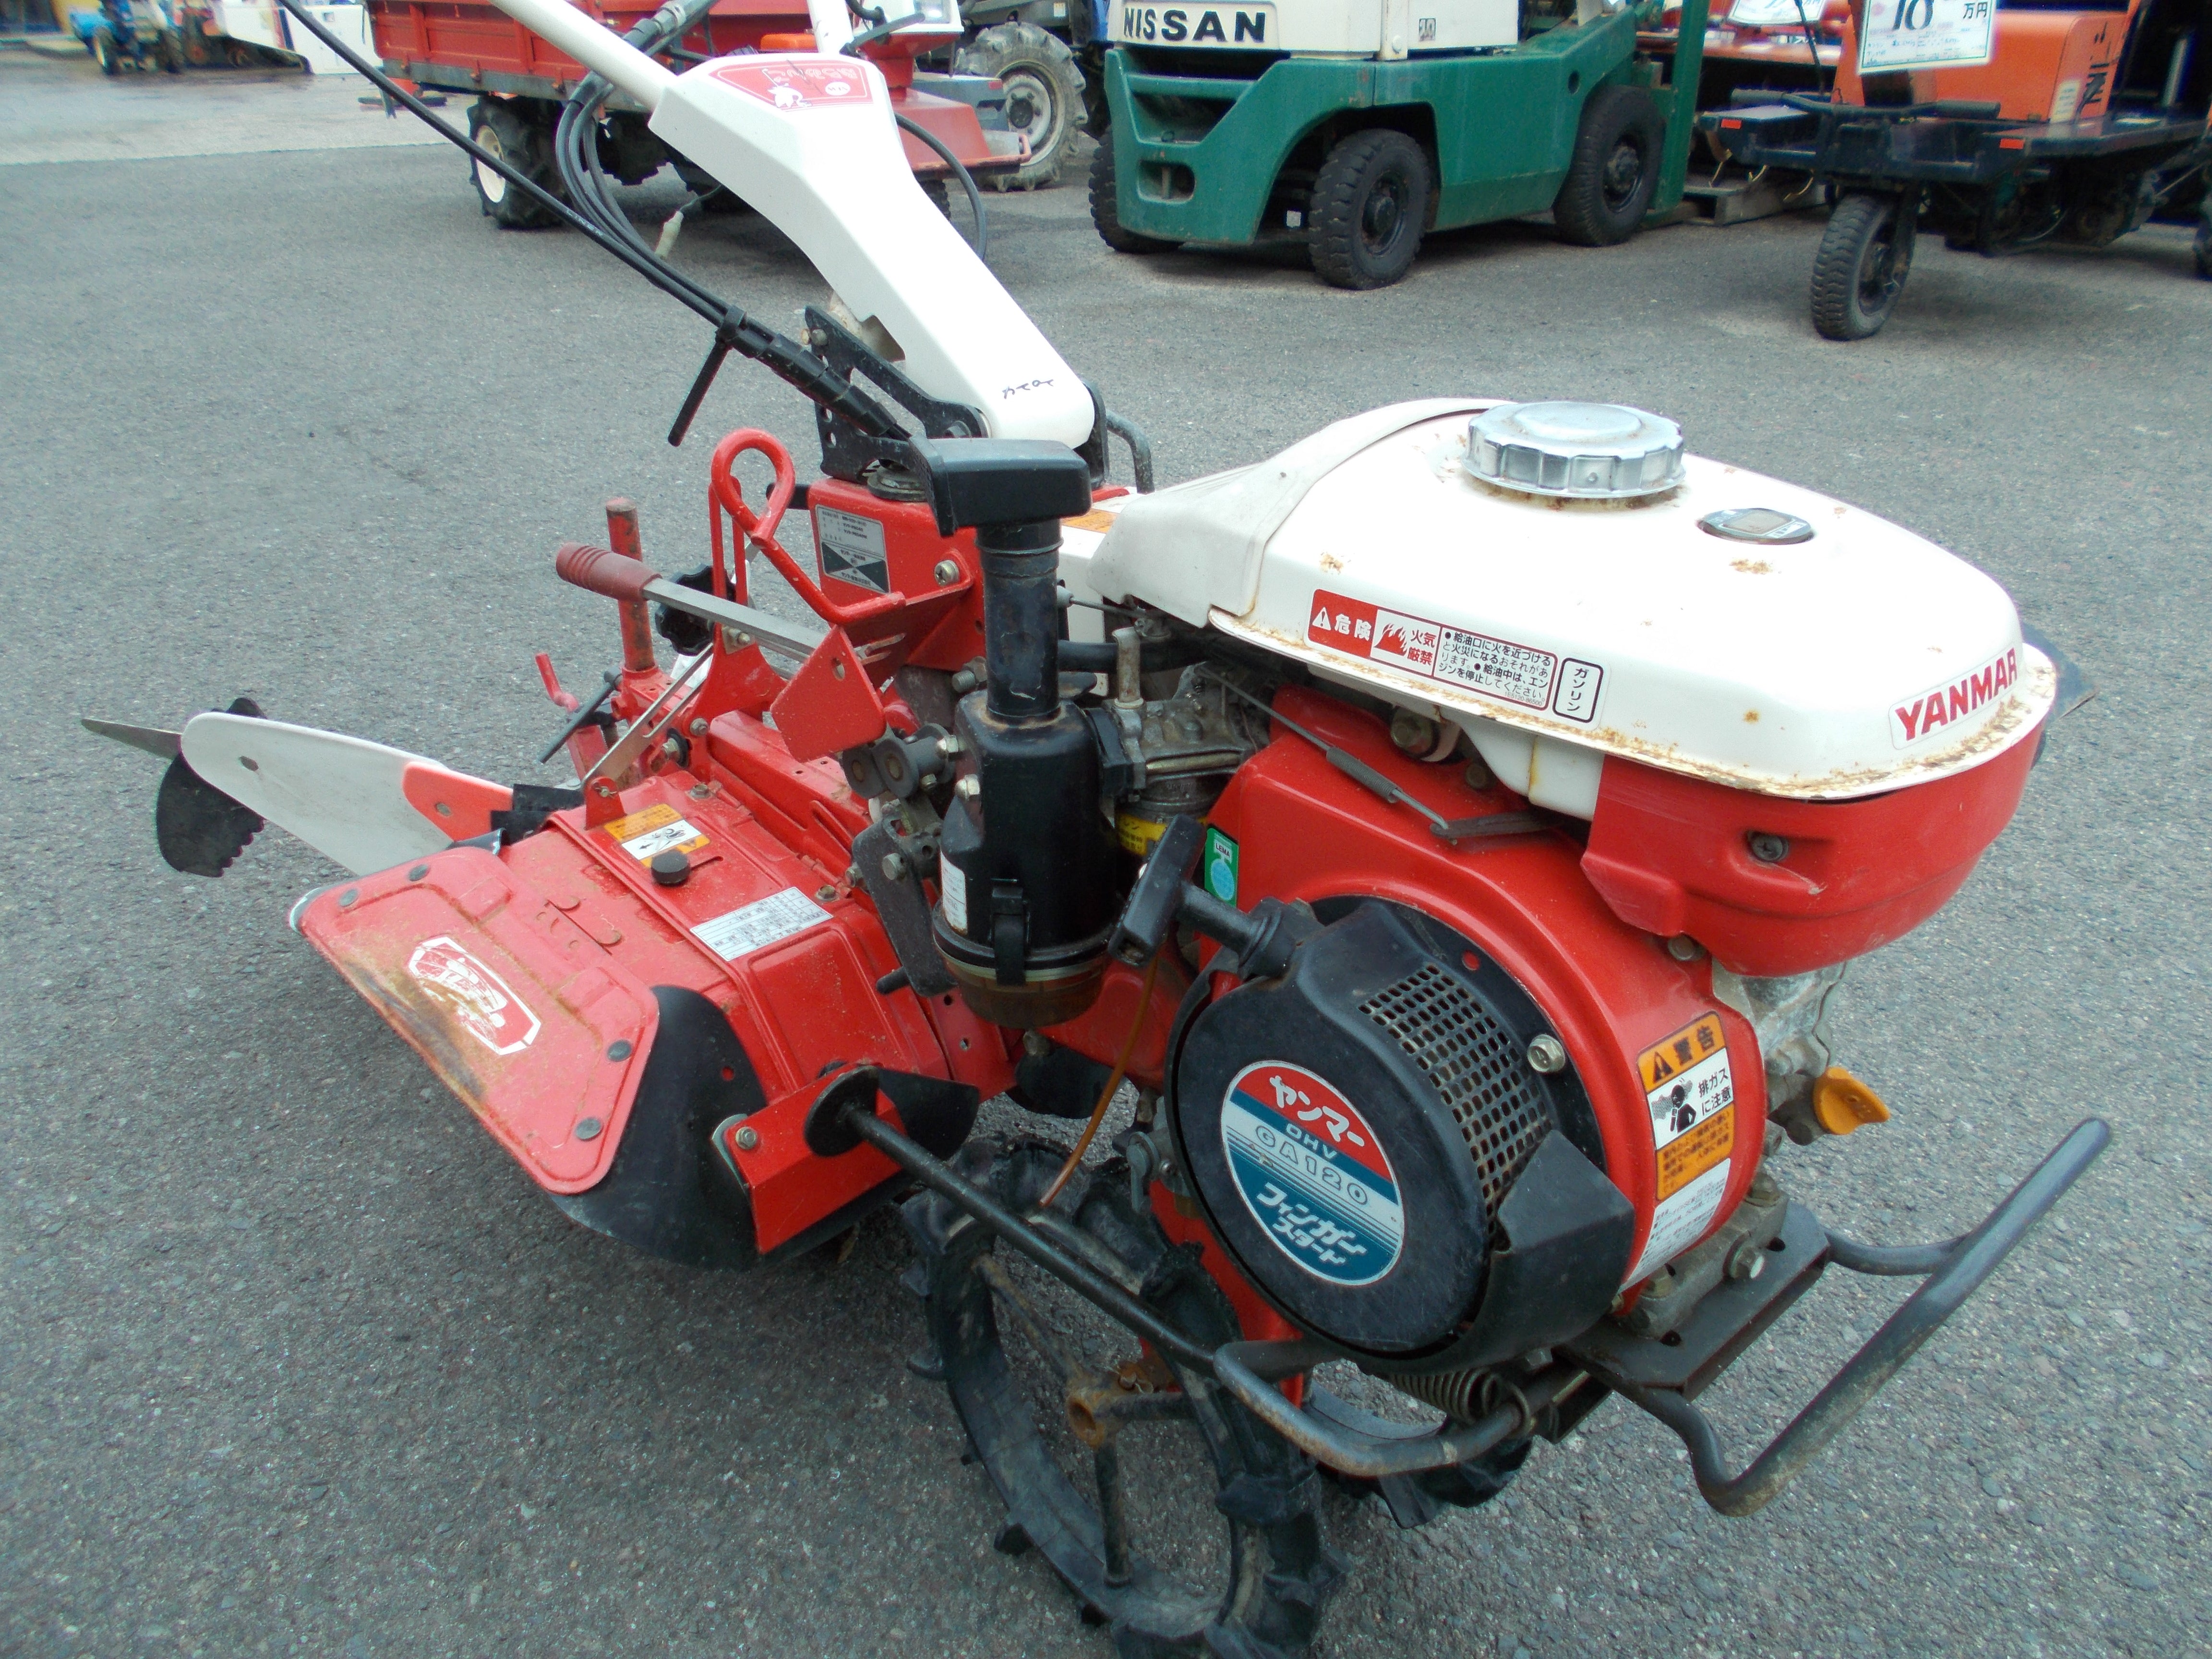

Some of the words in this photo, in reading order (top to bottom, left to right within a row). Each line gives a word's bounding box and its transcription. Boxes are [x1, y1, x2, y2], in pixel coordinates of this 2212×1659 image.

[1124, 8, 1266, 43] NISSAN
[1963, 1, 1988, 19] 万円
[1334, 613, 1372, 641] 危険
[1410, 629, 1437, 648] 火気
[1407, 647, 1433, 665] 厳禁
[1443, 641, 1549, 677] と火災になるおそれがあ
[1453, 632, 1551, 667] 給油口に火を近づける
[1438, 662, 1545, 702] ジンを停止してください。
[1567, 667, 1589, 711] ガソリン
[1895, 647, 2018, 741] YANMAR
[1215, 842, 1230, 857] LEMA
[1698, 1068, 1728, 1098] 排ガス
[1701, 1085, 1731, 1116] に注意
[1270, 1075, 1365, 1147] ヤンマー
[1286, 1123, 1337, 1159] OHV
[1256, 1126, 1368, 1205] GA120
[1256, 1182, 1367, 1254] フィンガー
[1273, 1216, 1346, 1263] スタート
